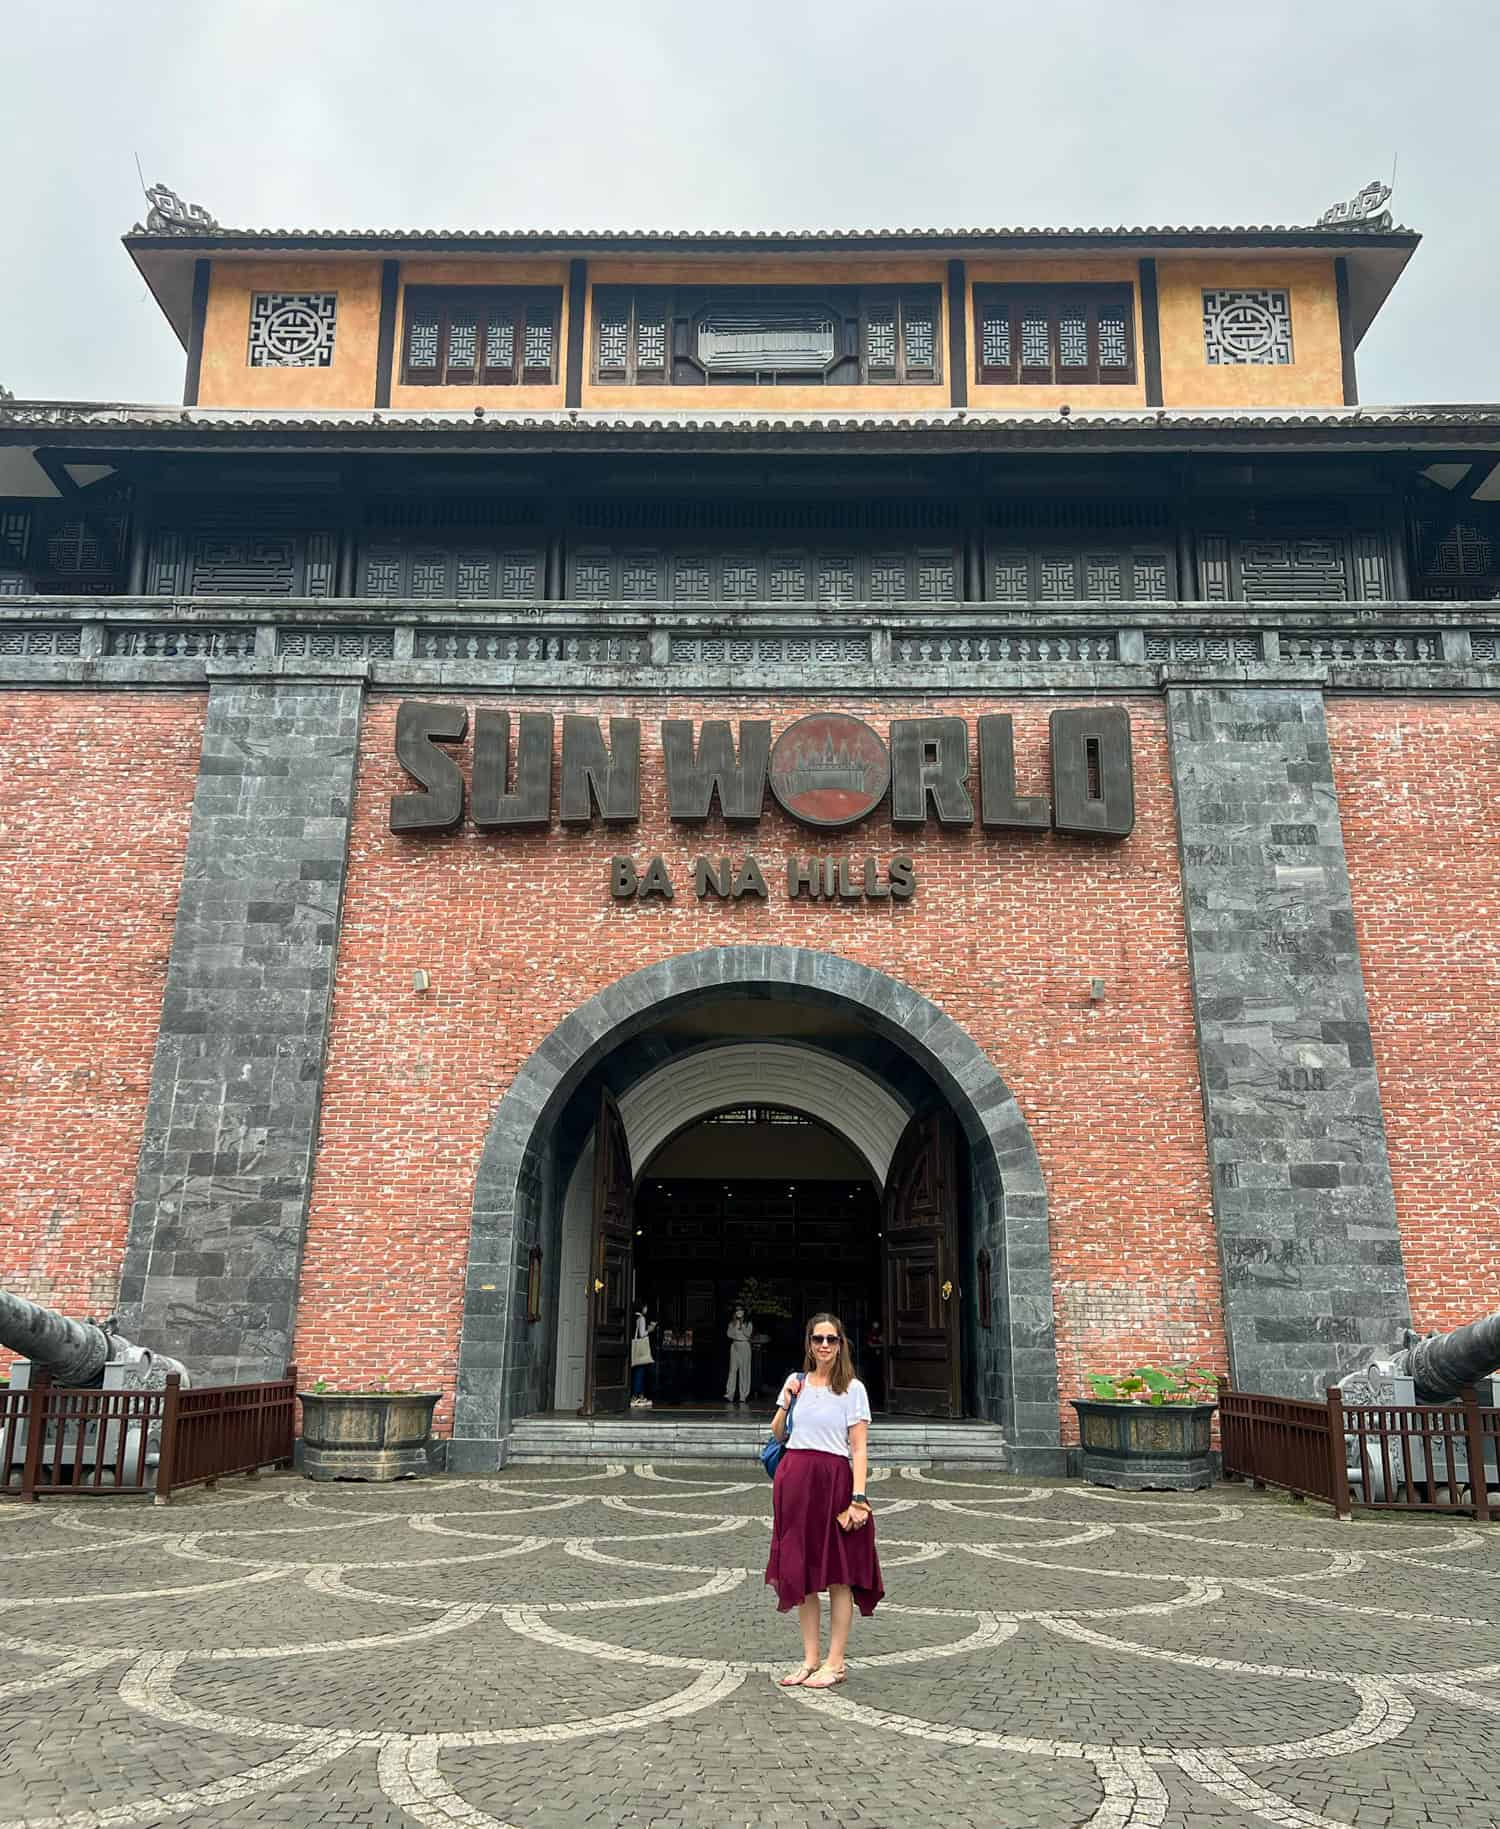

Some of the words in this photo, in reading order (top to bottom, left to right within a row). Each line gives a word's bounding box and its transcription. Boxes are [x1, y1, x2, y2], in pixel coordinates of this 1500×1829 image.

[390, 702, 641, 830] SUN
[661, 706, 1135, 839] WORLD
[611, 855, 673, 899] BA
[695, 855, 768, 899] NA
[788, 855, 916, 899] HILLS
